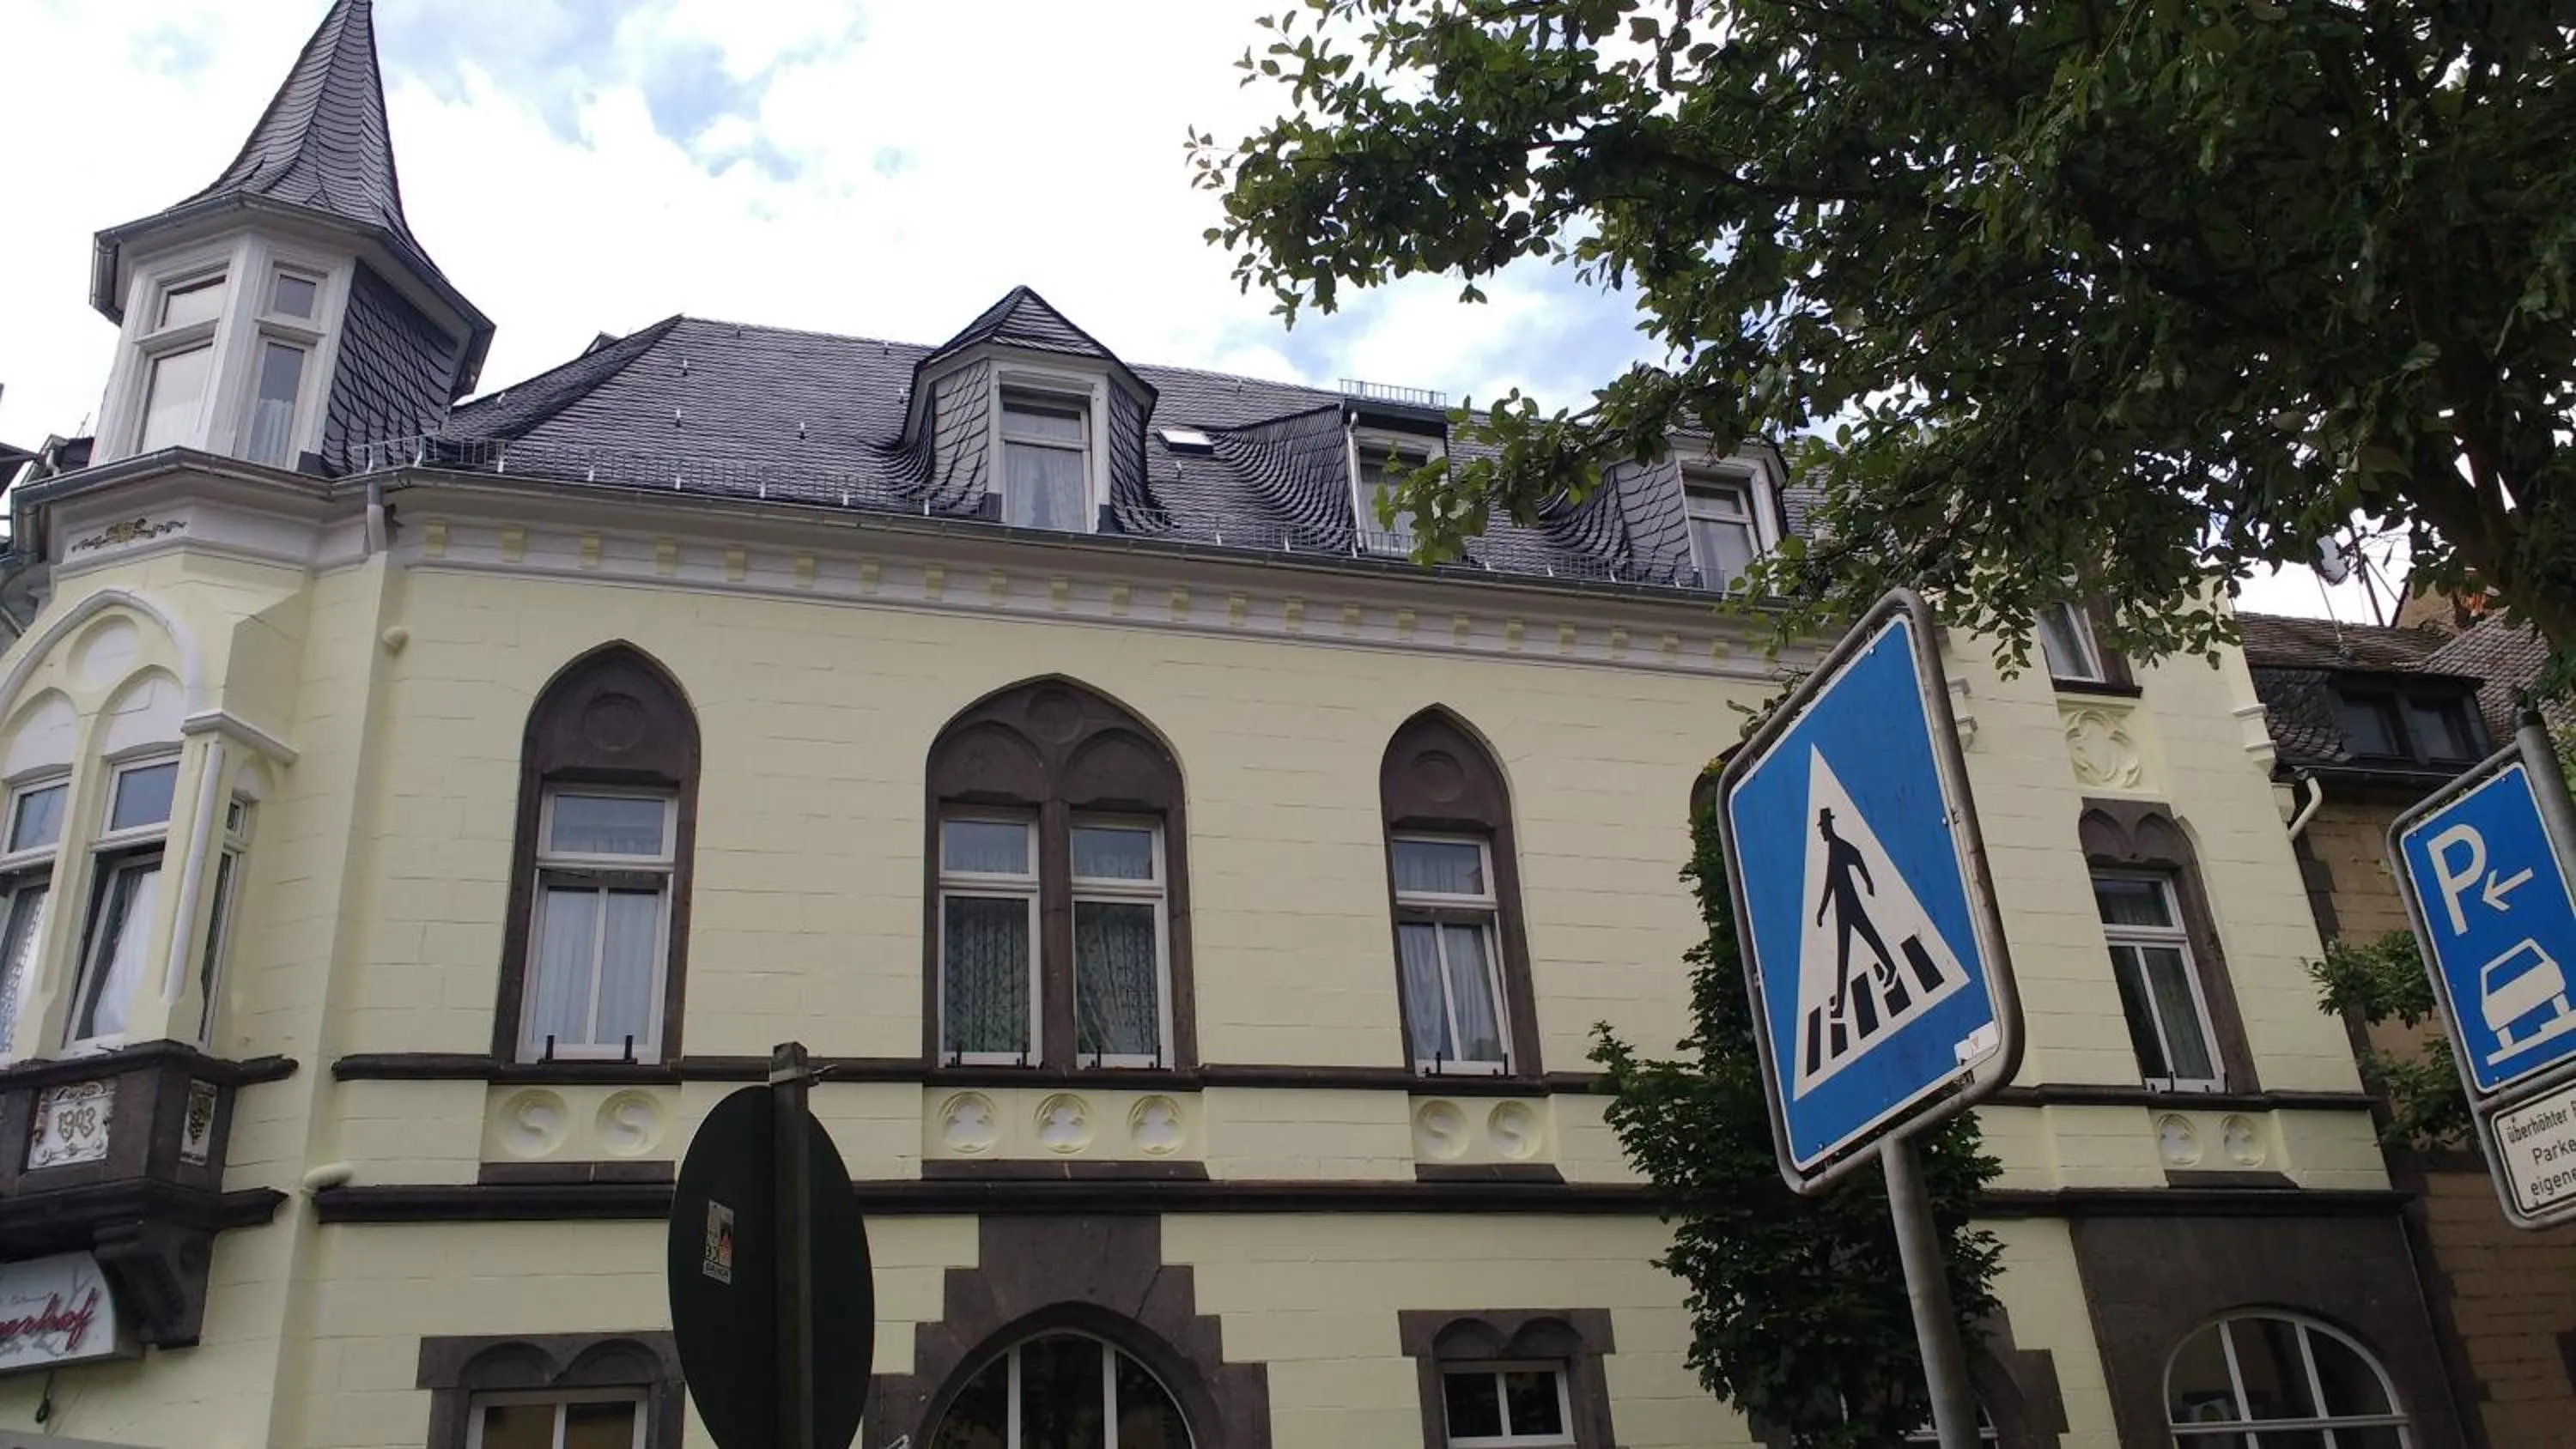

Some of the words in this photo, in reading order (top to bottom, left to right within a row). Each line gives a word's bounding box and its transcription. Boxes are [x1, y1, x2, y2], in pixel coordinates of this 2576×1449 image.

[2427, 823, 2487, 936] P
[2506, 1109, 2569, 1144] überhöhter
[2531, 1138, 2576, 1166] Parke
